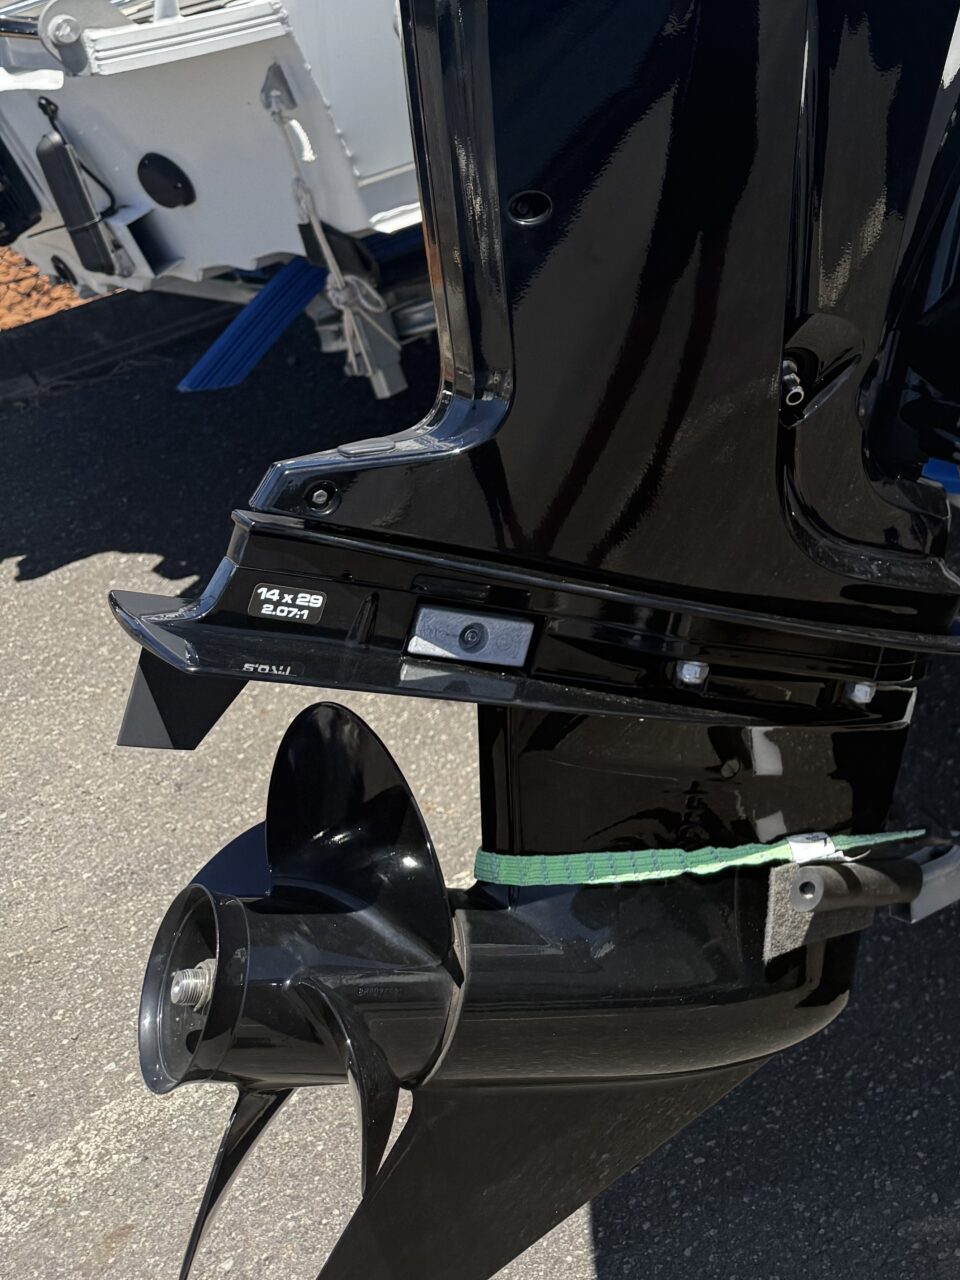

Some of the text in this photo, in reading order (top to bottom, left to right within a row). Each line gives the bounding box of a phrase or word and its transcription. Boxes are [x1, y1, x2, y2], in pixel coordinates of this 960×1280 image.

[257, 587, 323, 608] 14 x 29
[261, 603, 309, 620] 2.07:1
